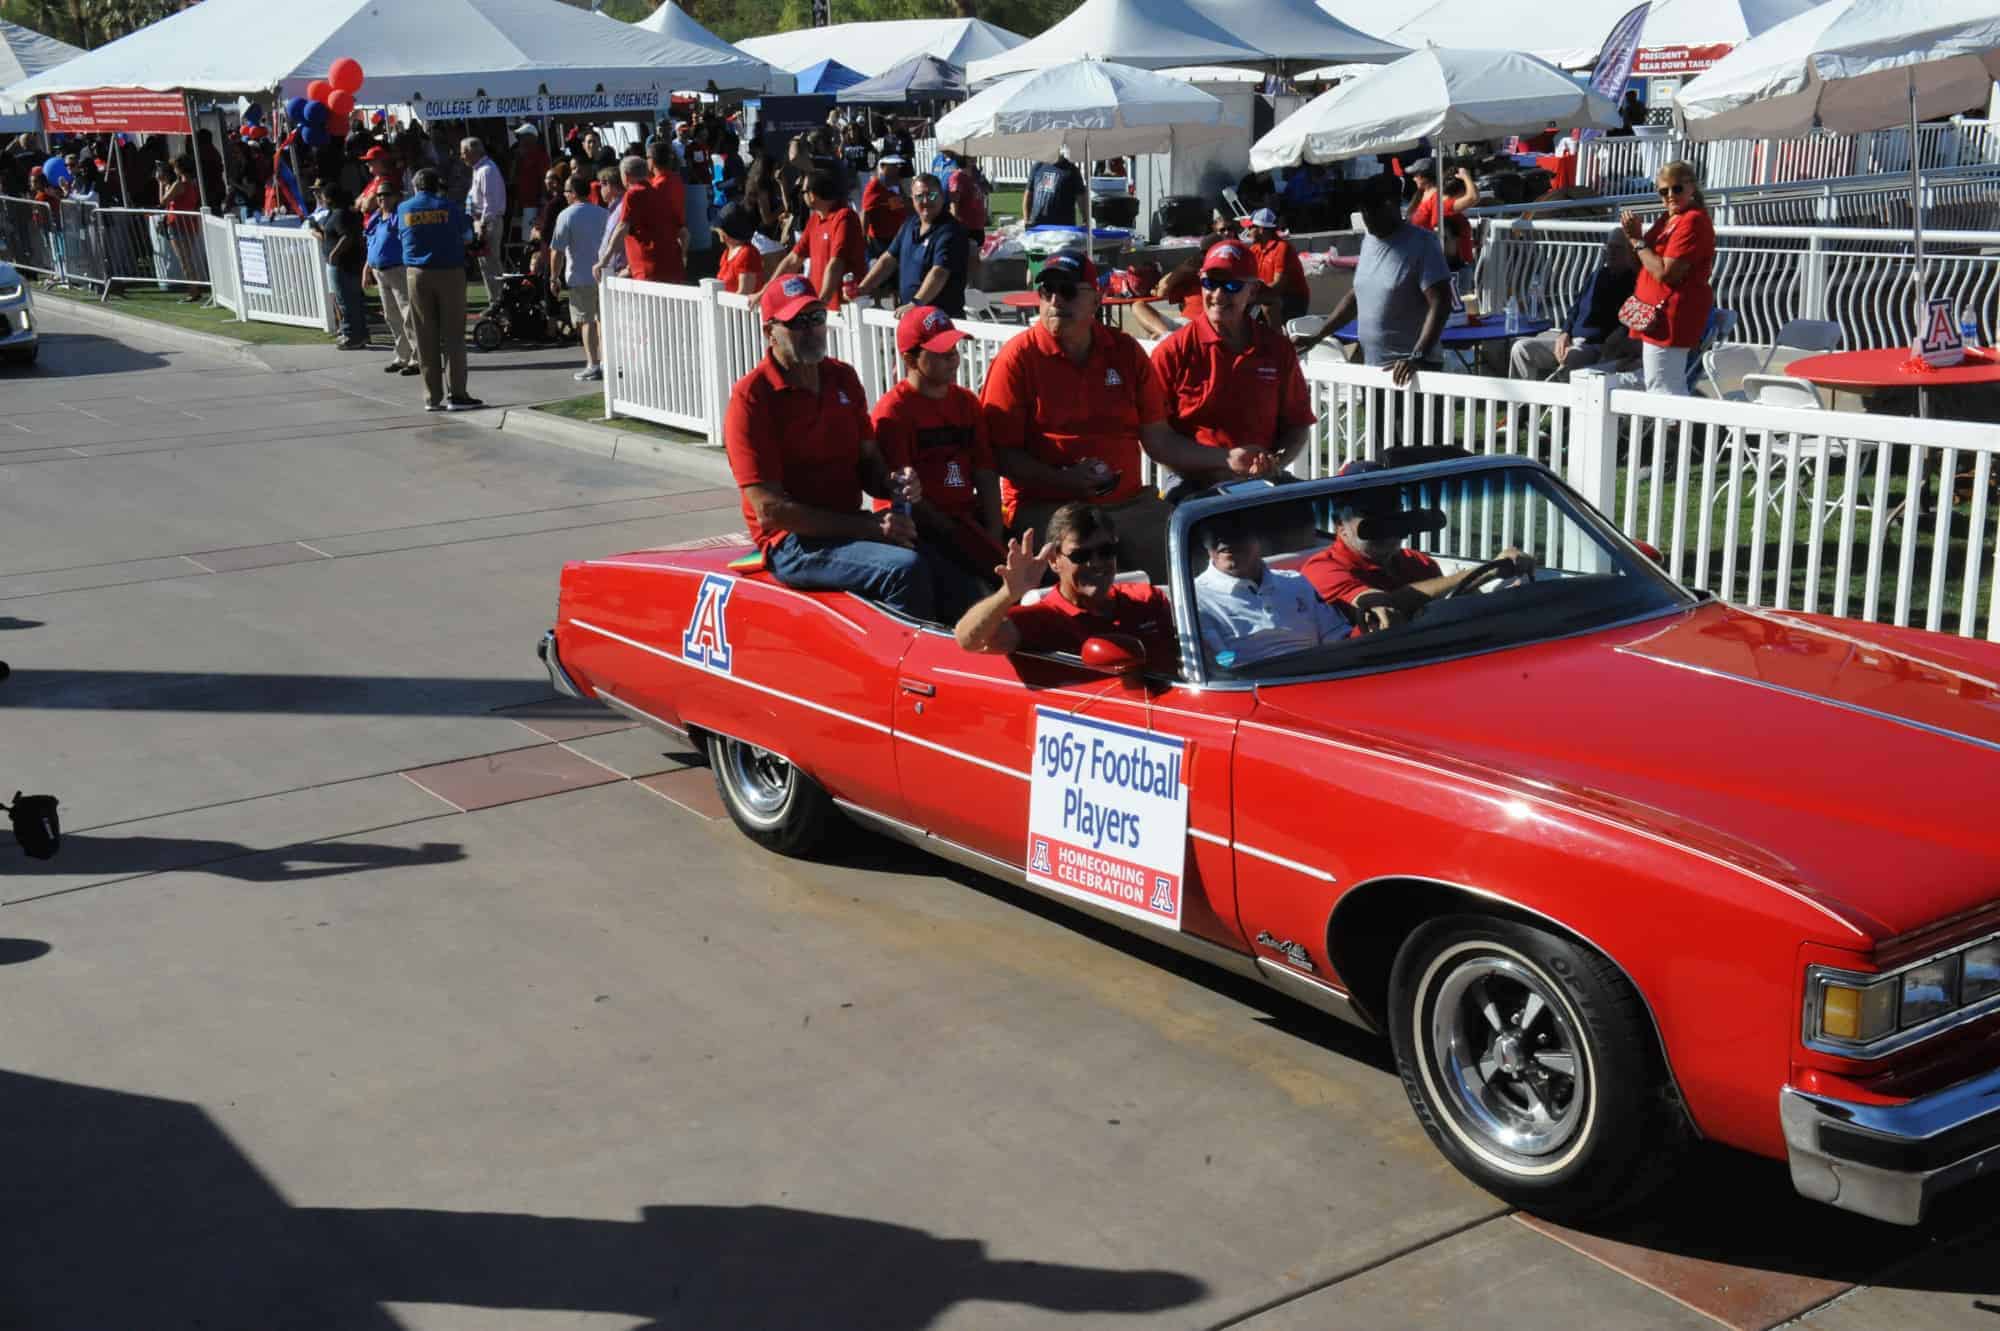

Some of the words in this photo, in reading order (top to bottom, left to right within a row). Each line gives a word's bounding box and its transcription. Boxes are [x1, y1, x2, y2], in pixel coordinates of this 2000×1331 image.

[1640, 51, 1688, 60] PRESIDENT'S
[1640, 62, 1660, 70] BEAR
[1662, 61, 1687, 69] DOWN
[426, 100, 472, 116] COLLEGE
[478, 98, 491, 114] OF
[497, 98, 531, 113] SOCIAL
[537, 97, 544, 111] &
[548, 95, 608, 111] BEHAVIORAL
[615, 92, 659, 108] SCIENCES
[1922, 297, 1962, 353] A
[683, 572, 737, 675] A
[1040, 732, 1086, 784] 1967
[1091, 738, 1180, 801] Football
[1063, 788, 1140, 849] Players
[1030, 840, 1054, 874] A
[1058, 847, 1145, 886] HOMECOMING
[1057, 863, 1144, 903] CELEBRATION
[1151, 878, 1173, 913] A
